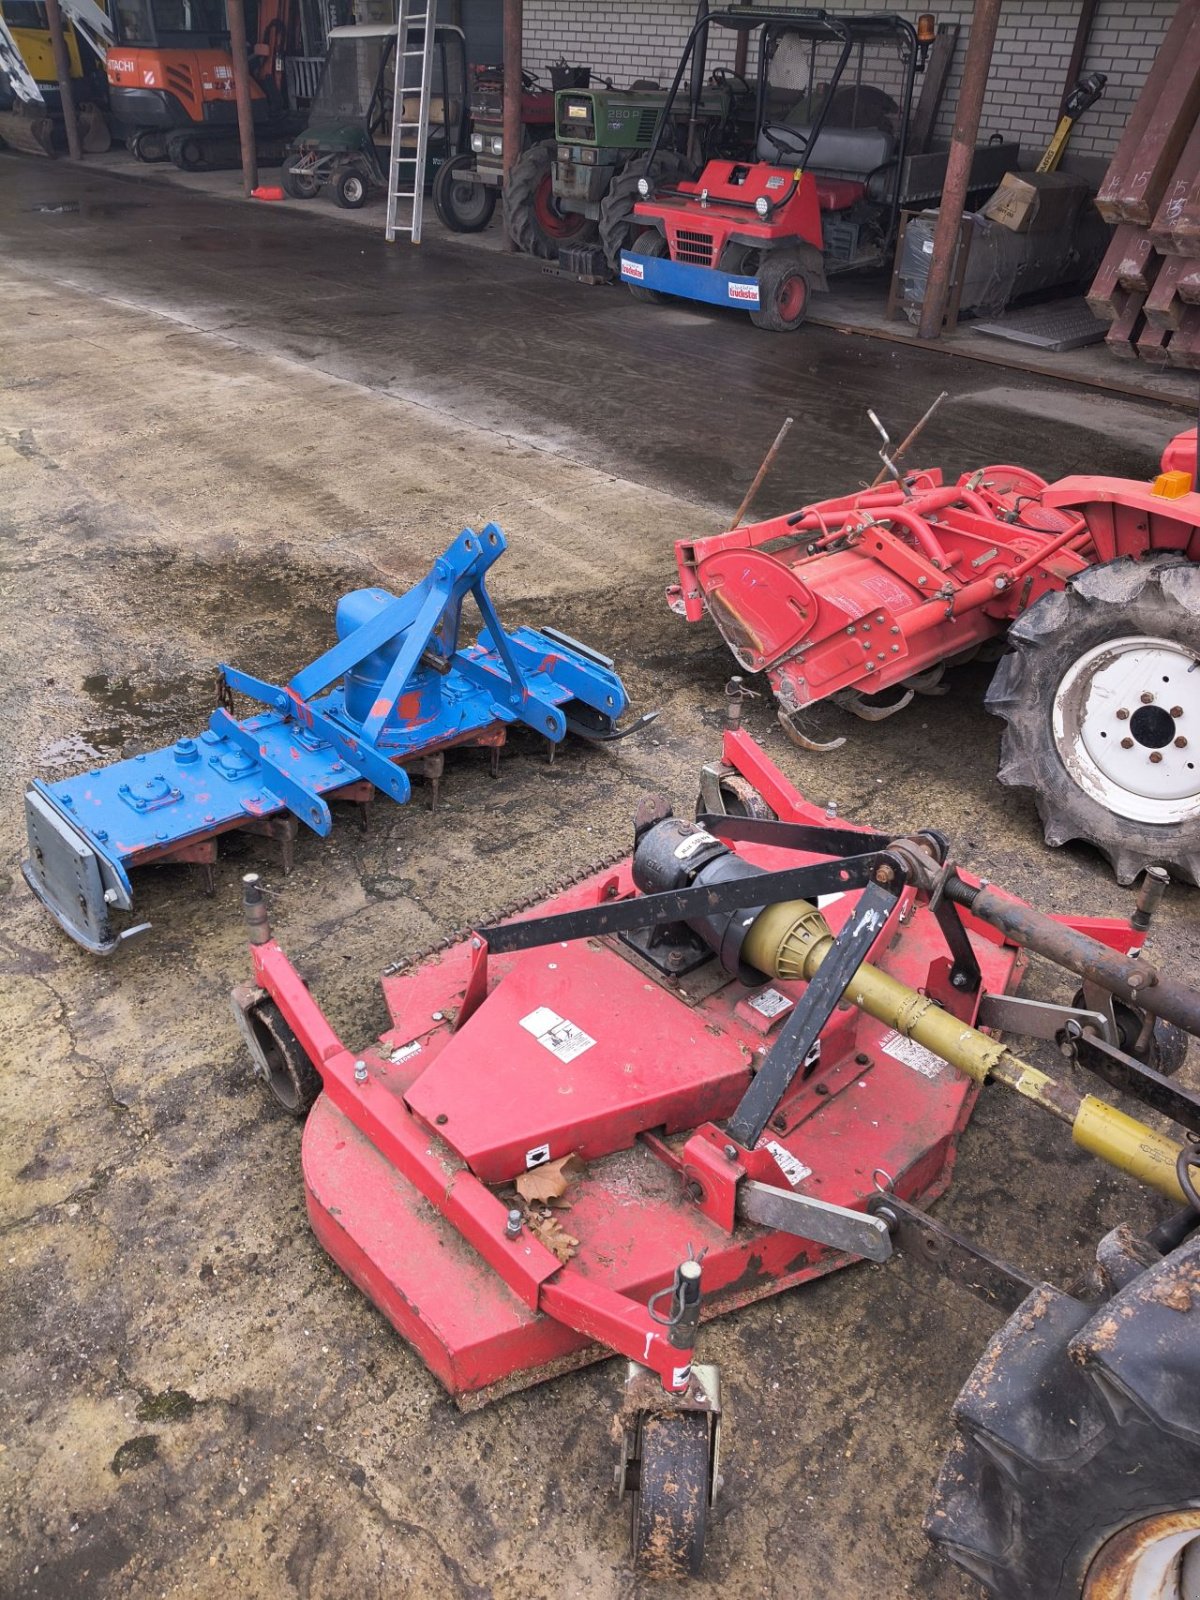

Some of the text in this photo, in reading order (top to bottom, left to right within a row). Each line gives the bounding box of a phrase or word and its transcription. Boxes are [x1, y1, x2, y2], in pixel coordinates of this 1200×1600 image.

[607, 109, 640, 119] 280 P
[1131, 171, 1151, 189] 15
